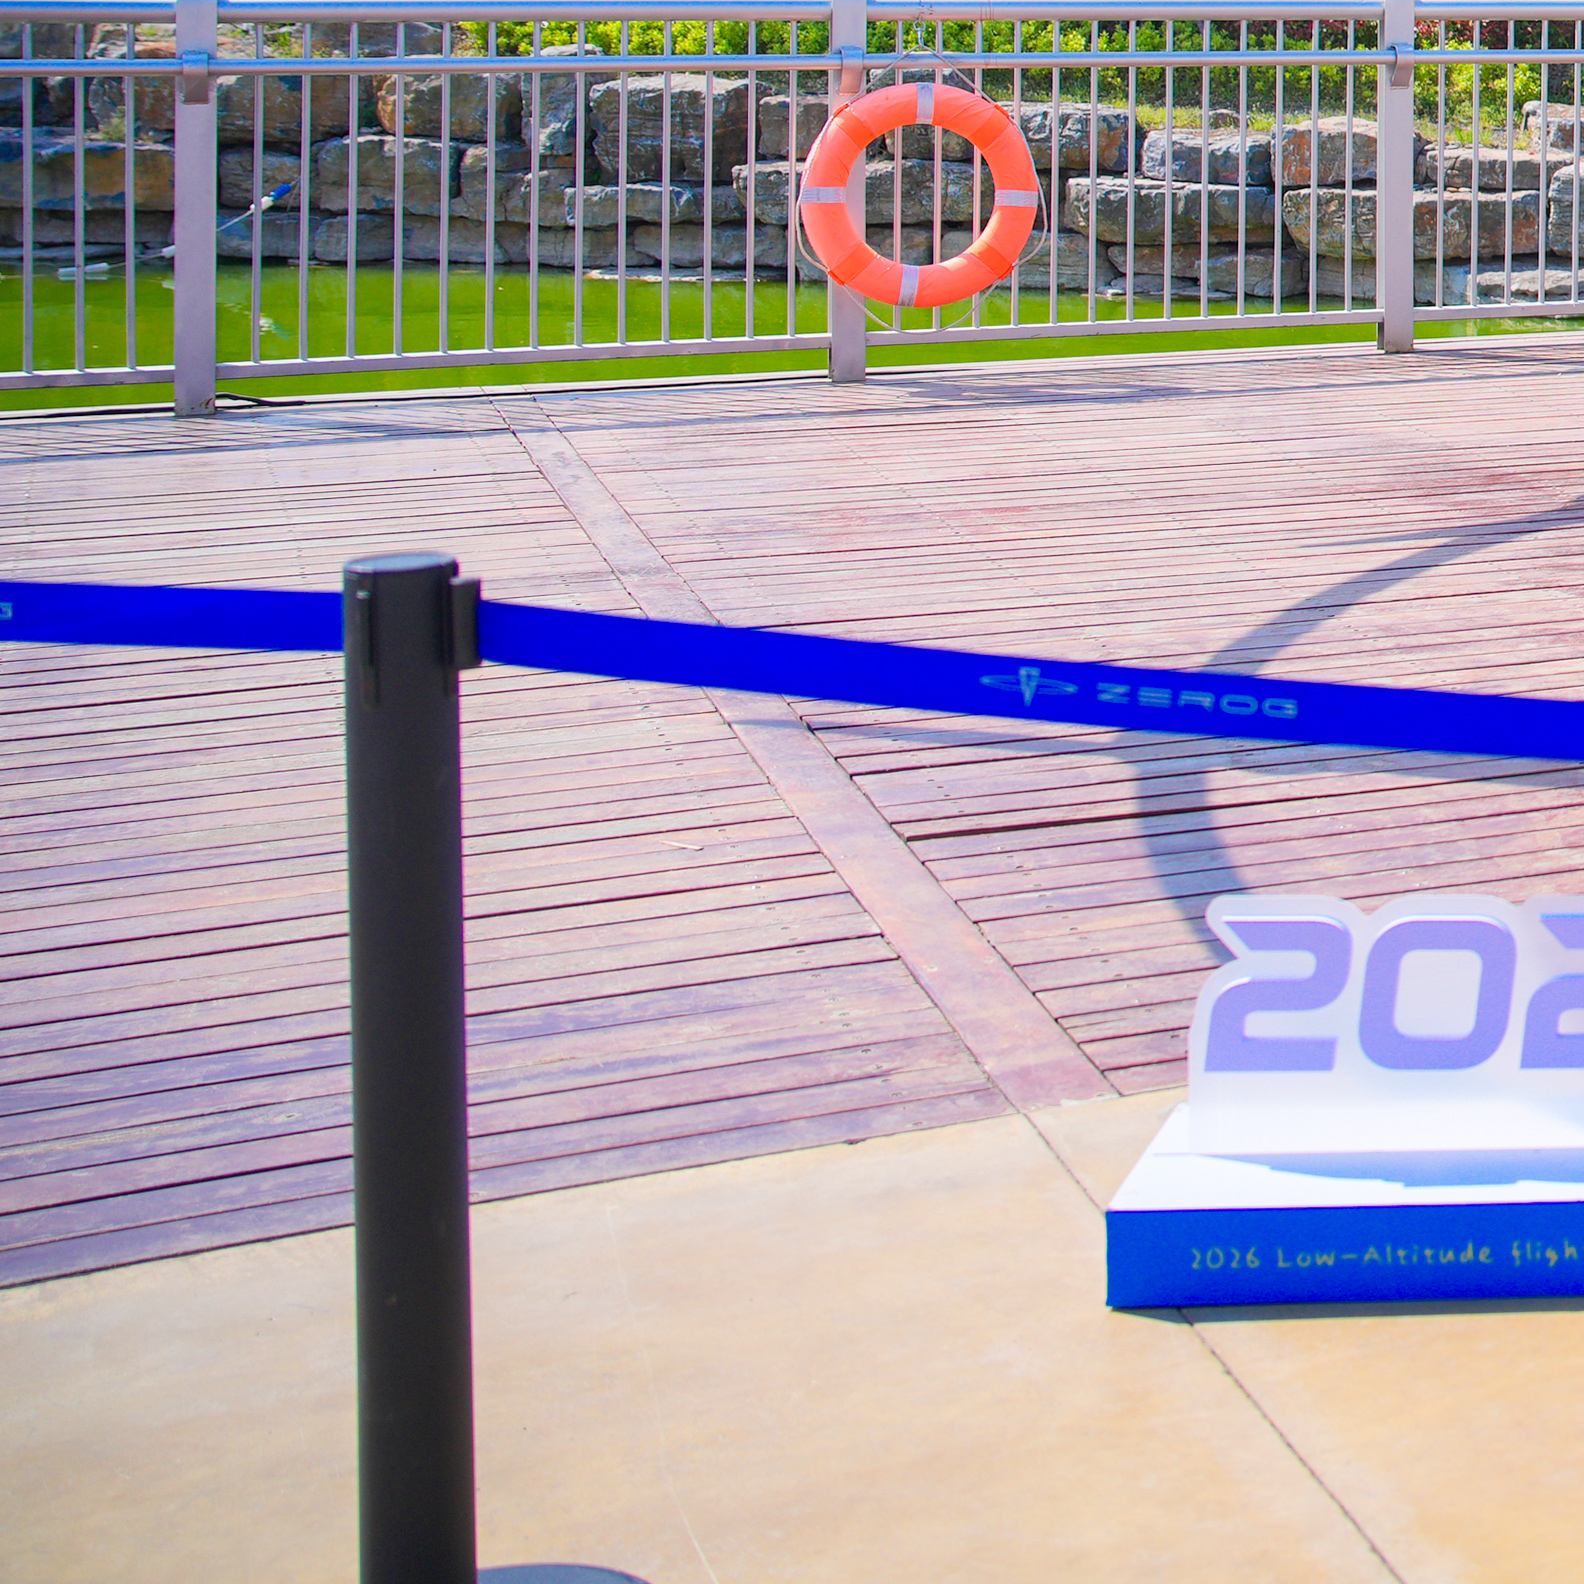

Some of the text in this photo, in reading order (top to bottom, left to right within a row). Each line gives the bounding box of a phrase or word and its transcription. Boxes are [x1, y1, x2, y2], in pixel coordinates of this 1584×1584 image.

[1096, 682, 1299, 720] ZEROG
[1191, 1245, 1261, 1269] 2026
[1277, 1239, 1491, 1268] Low-Altitude
